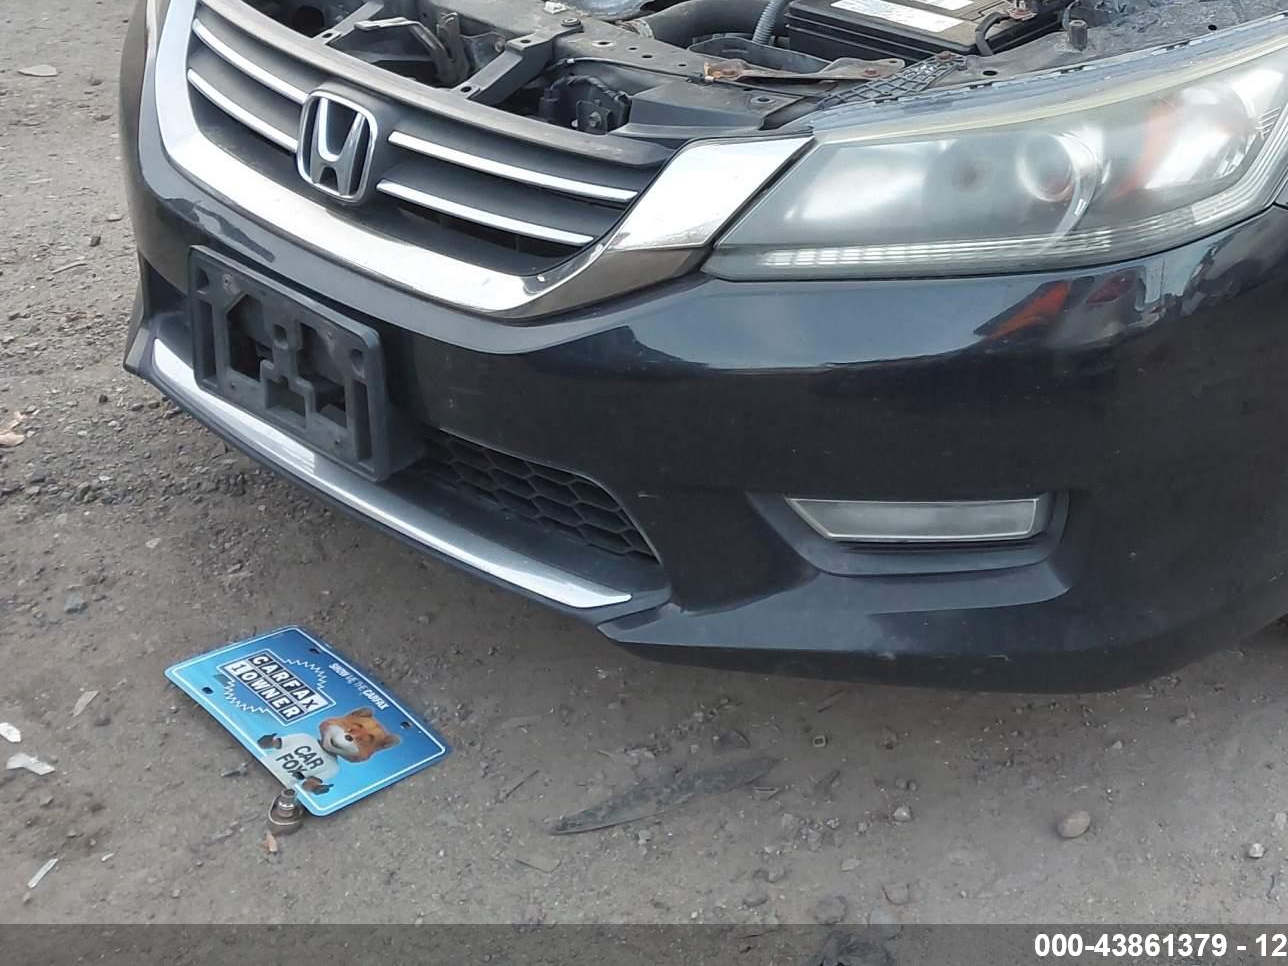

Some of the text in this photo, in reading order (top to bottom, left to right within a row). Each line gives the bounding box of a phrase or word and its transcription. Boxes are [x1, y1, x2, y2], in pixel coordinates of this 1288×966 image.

[241, 672, 301, 718] OWNER
[252, 655, 320, 709] CARFAX
[275, 753, 308, 774] FOX
[294, 745, 324, 770] CAR
